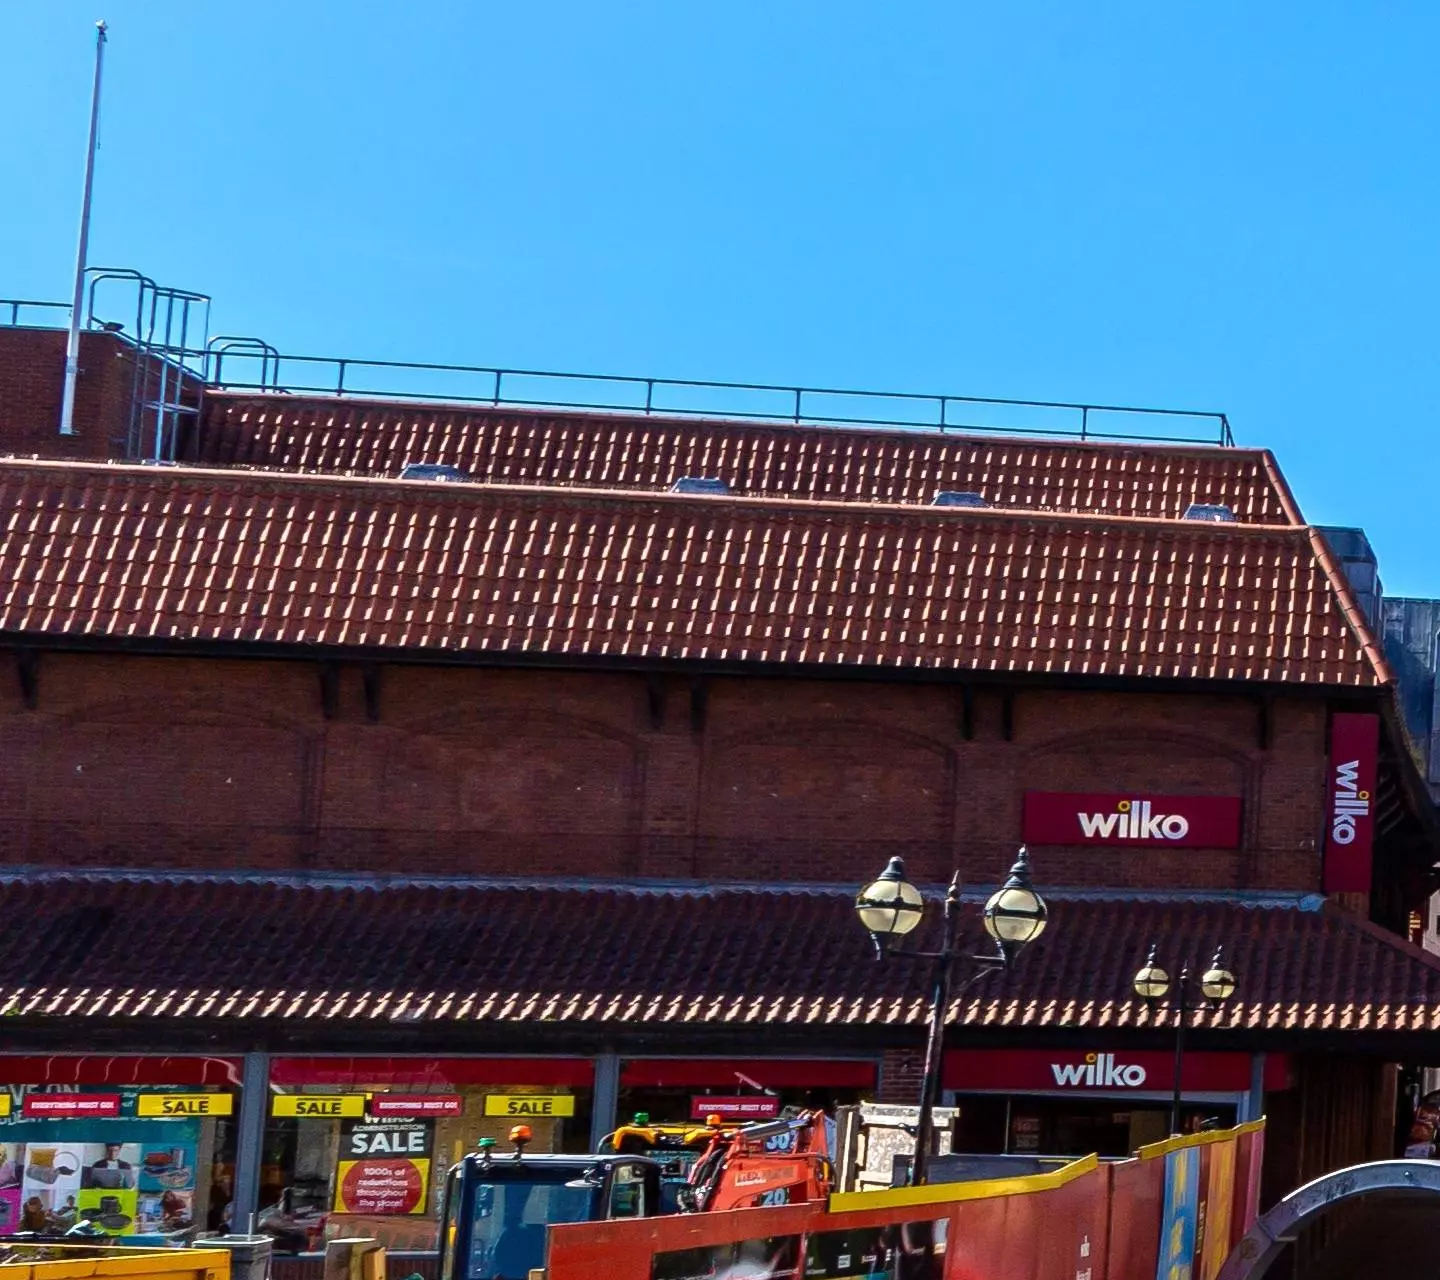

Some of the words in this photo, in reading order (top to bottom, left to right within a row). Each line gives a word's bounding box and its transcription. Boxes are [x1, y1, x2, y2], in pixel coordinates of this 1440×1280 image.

[1332, 760, 1368, 844] wilko
[1078, 800, 1189, 840] wilko
[1051, 1053, 1146, 1087] wilko
[162, 1100, 209, 1114] SALE
[296, 1102, 342, 1115] SALE
[507, 1101, 553, 1114] SALE
[351, 1132, 425, 1153] SALE
[363, 1167, 393, 1176] 1000s
[394, 1167, 406, 1176] of
